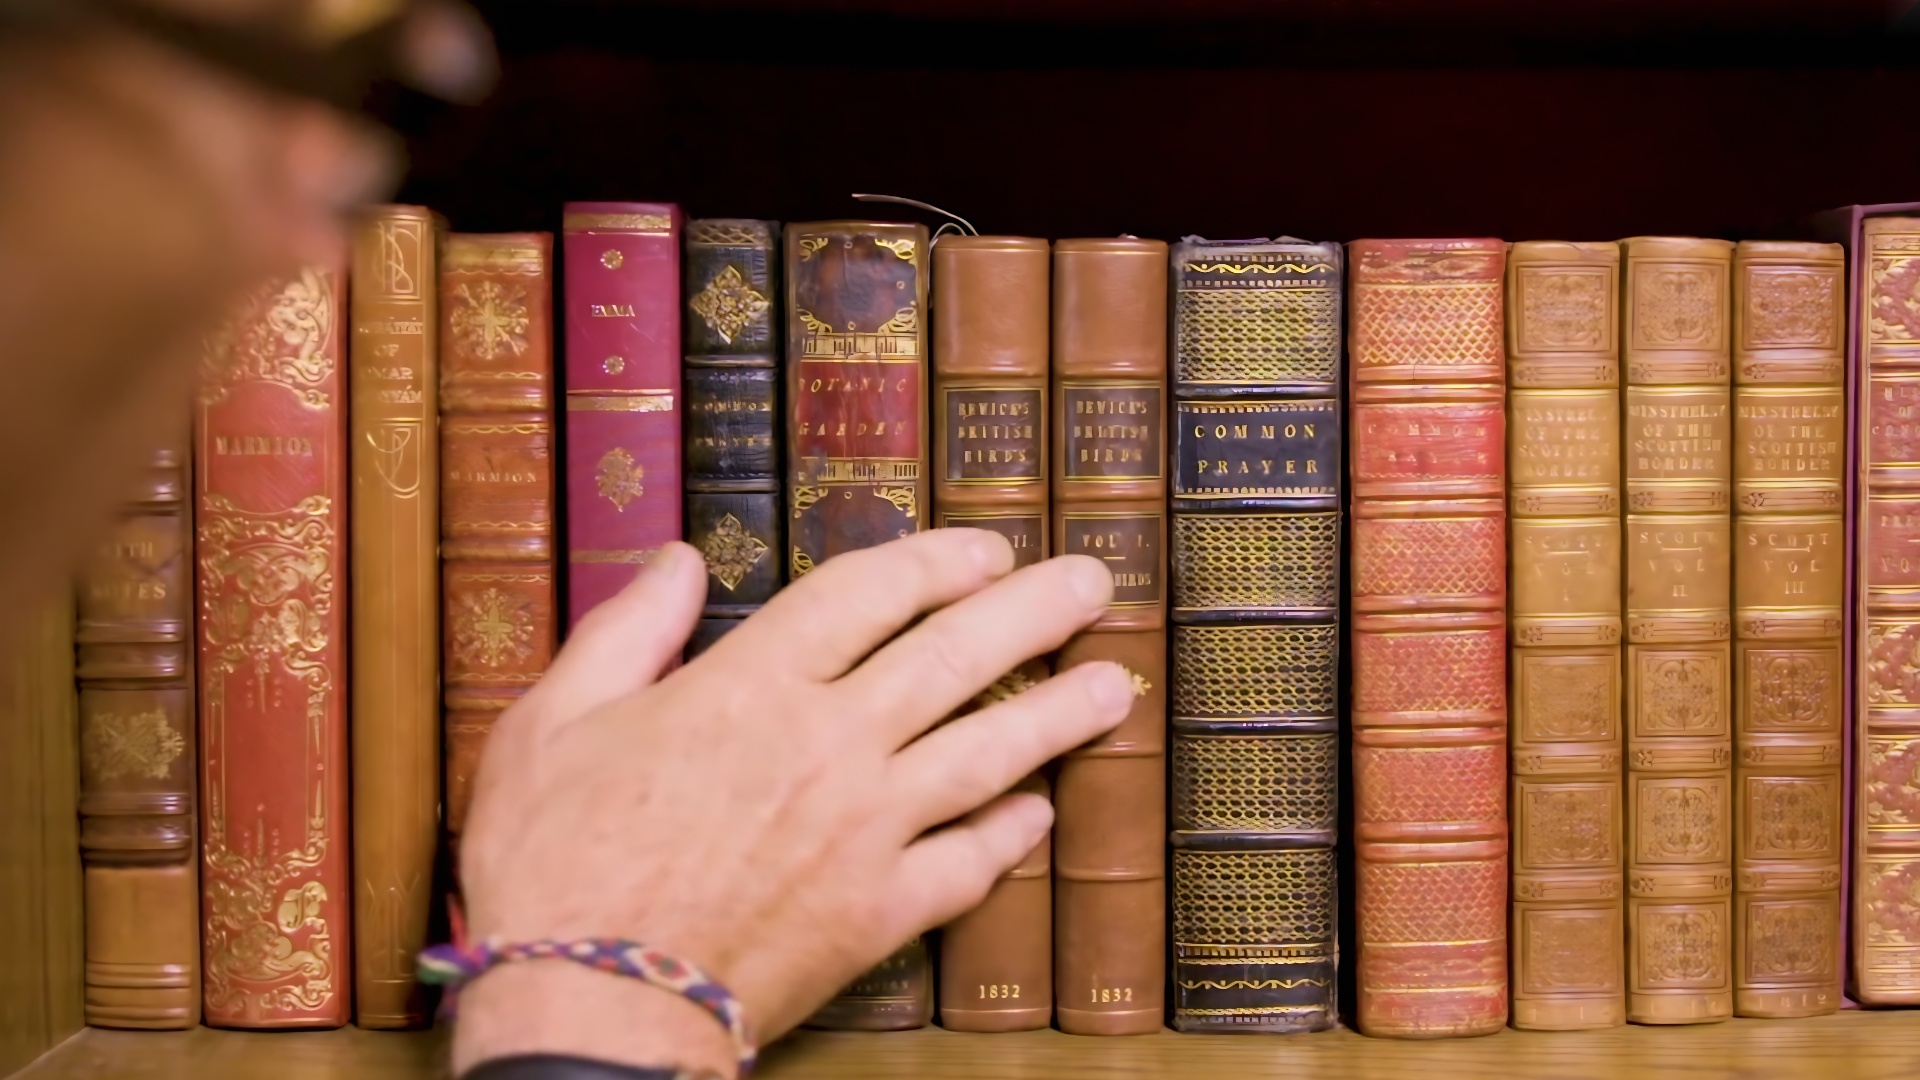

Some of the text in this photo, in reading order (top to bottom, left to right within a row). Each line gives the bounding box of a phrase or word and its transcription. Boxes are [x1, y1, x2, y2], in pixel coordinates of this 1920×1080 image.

[799, 421, 907, 436] GARDEN
[958, 425, 1033, 439] BRITISH
[1074, 425, 1148, 440] BRITISH
[1194, 423, 1316, 440] COMMON
[1642, 423, 1712, 438] OF THE
[1754, 424, 1825, 438] OF THE
[1634, 439, 1722, 453] SCOTTISH
[1747, 441, 1837, 455] SCOTTISH
[964, 449, 1026, 463] BIRDS
[1080, 448, 1142, 463] BIRDS
[1197, 458, 1318, 474] PRAYER
[1638, 457, 1715, 471] BORDER
[1753, 458, 1831, 472] BORDER
[1748, 532, 1830, 546] SCOTT
[1763, 559, 1817, 574] VOL
[979, 985, 1020, 999] 1832
[1091, 988, 1132, 1003] 1832
